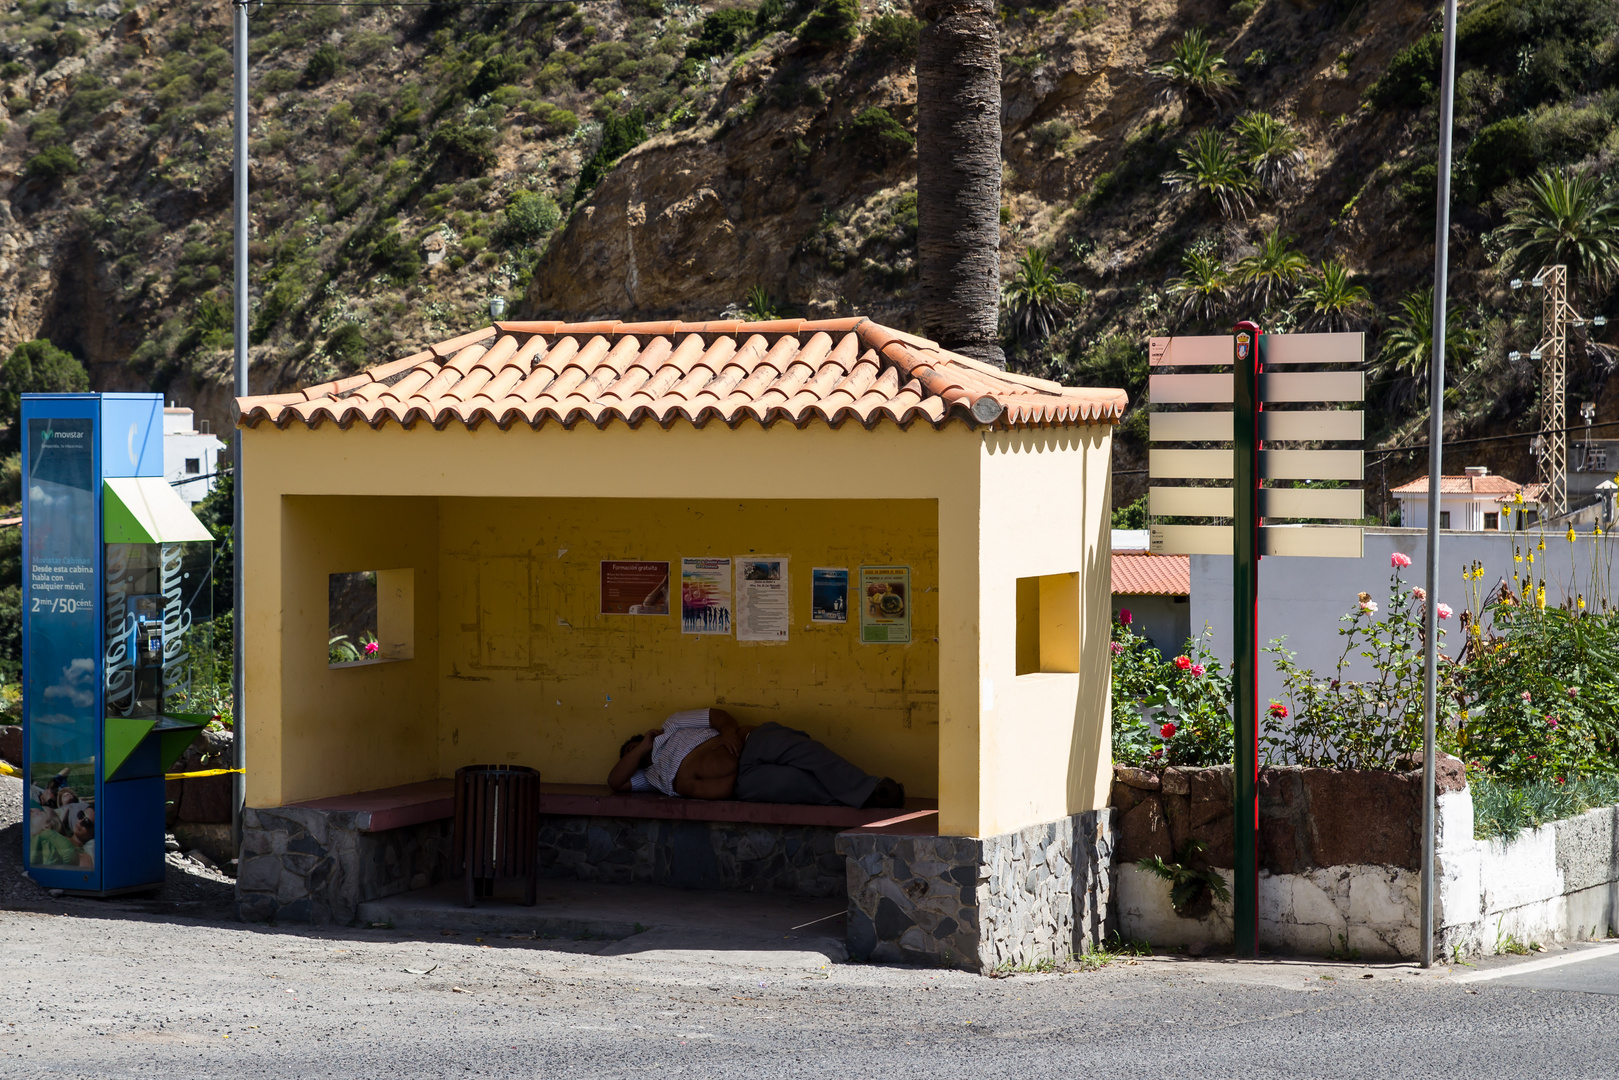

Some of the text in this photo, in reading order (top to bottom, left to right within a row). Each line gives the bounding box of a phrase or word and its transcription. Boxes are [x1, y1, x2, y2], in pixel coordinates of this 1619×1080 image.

[54, 430, 84, 439] movistar
[62, 556, 91, 564] Cabinas
[32, 564, 53, 573] Desde
[69, 565, 93, 573] cabina
[612, 563, 658, 572] Formación gratuita
[32, 573, 50, 581] habla
[31, 581, 86, 591] cualquier móvil.
